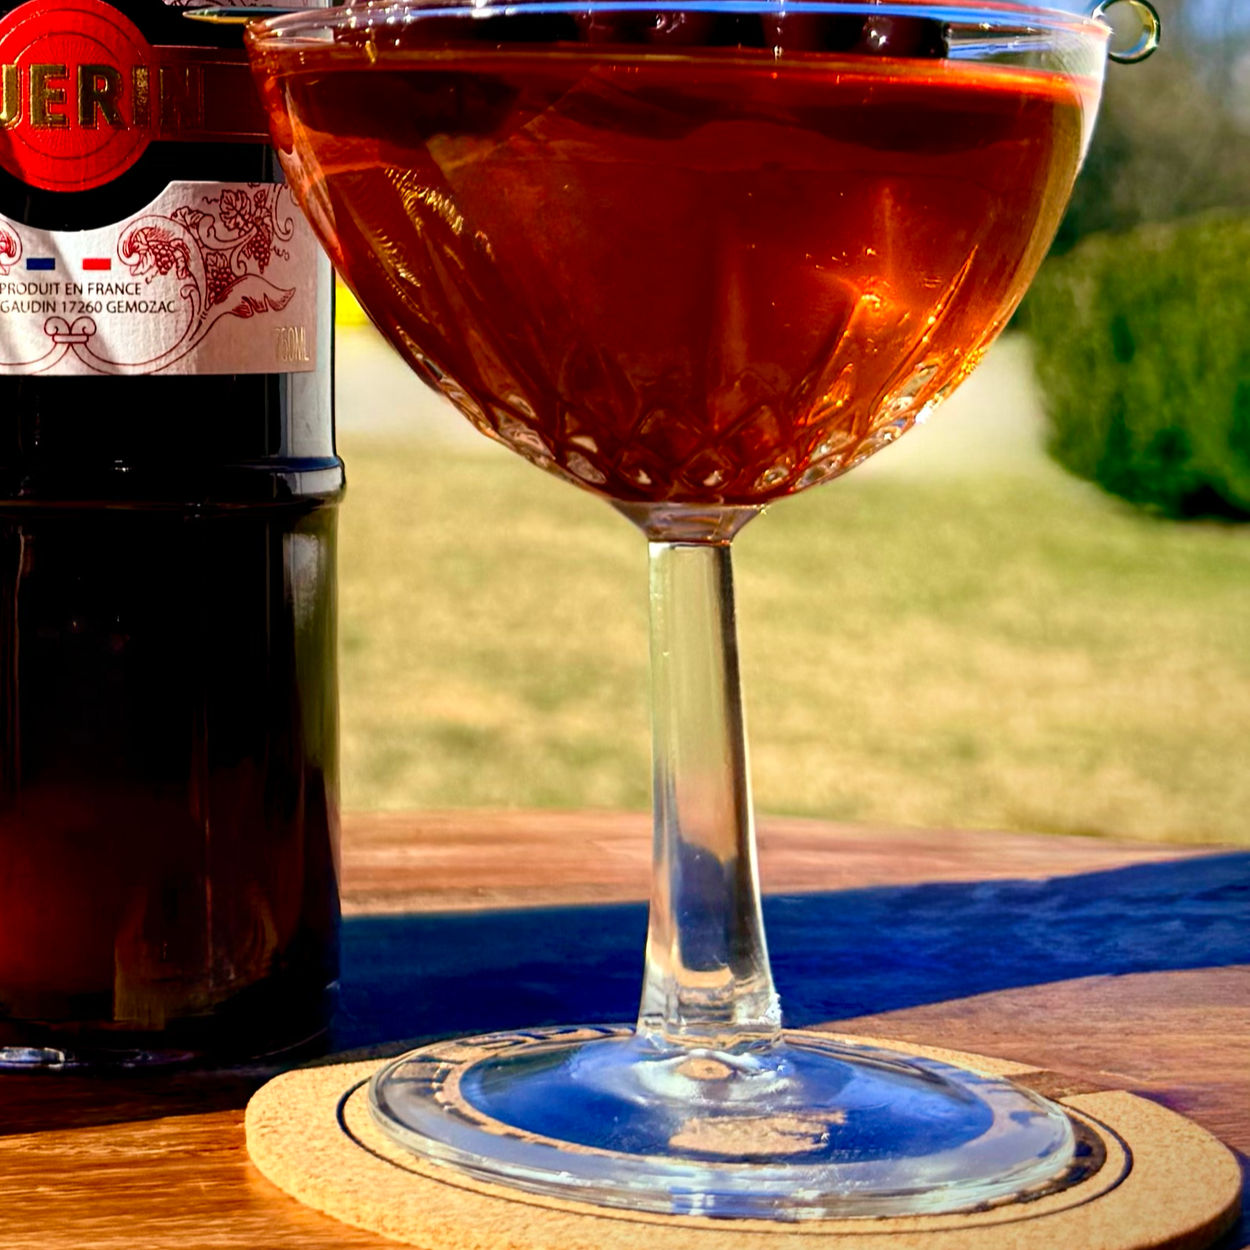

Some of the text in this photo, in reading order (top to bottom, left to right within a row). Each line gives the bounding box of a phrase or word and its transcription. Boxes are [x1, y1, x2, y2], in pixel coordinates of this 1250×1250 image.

[0, 282, 141, 296] PRODUIT EN FRANCE
[0, 300, 56, 313] GAUDIN
[62, 300, 103, 313] 17260
[106, 300, 176, 313] GEMOZAC
